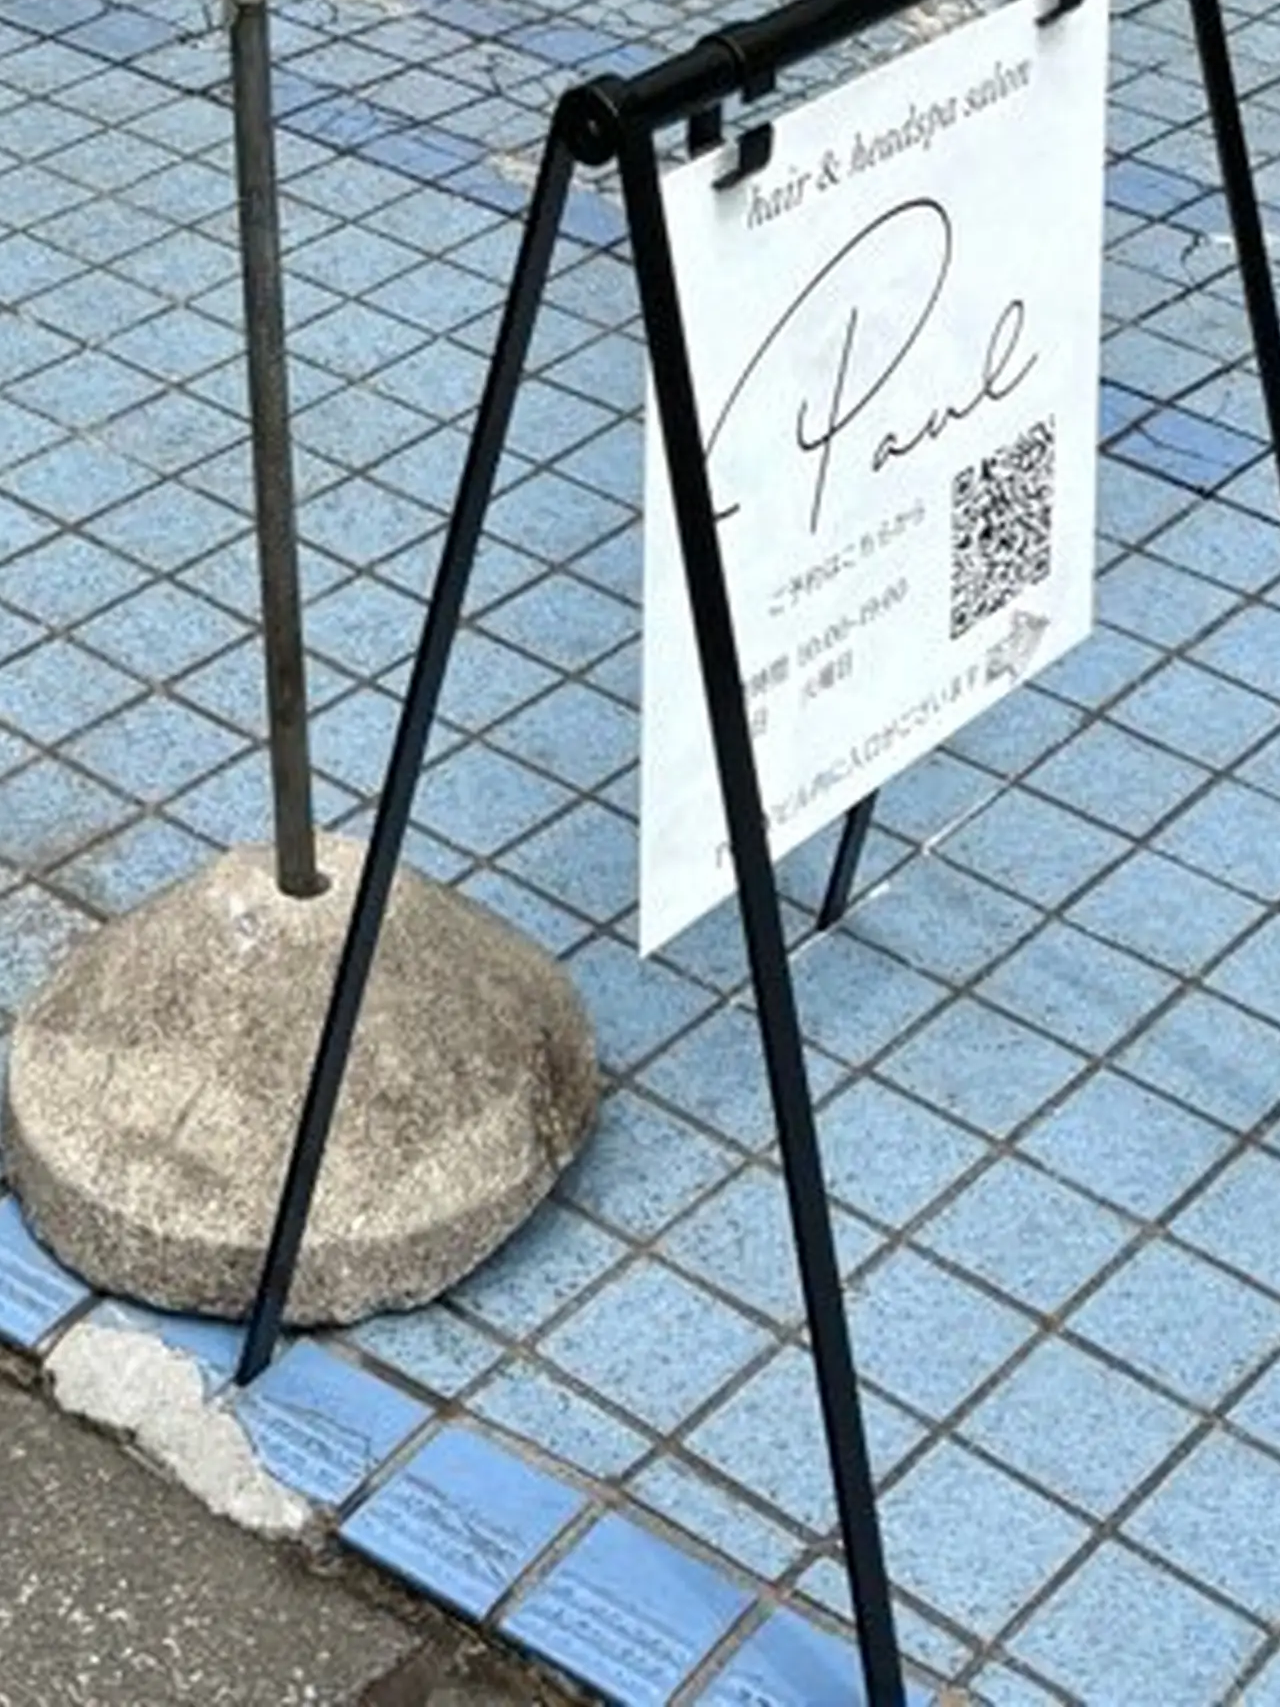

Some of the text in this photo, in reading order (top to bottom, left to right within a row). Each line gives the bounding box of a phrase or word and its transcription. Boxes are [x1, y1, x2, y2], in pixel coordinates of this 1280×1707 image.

[746, 59, 1031, 231] hair & headspa salon
